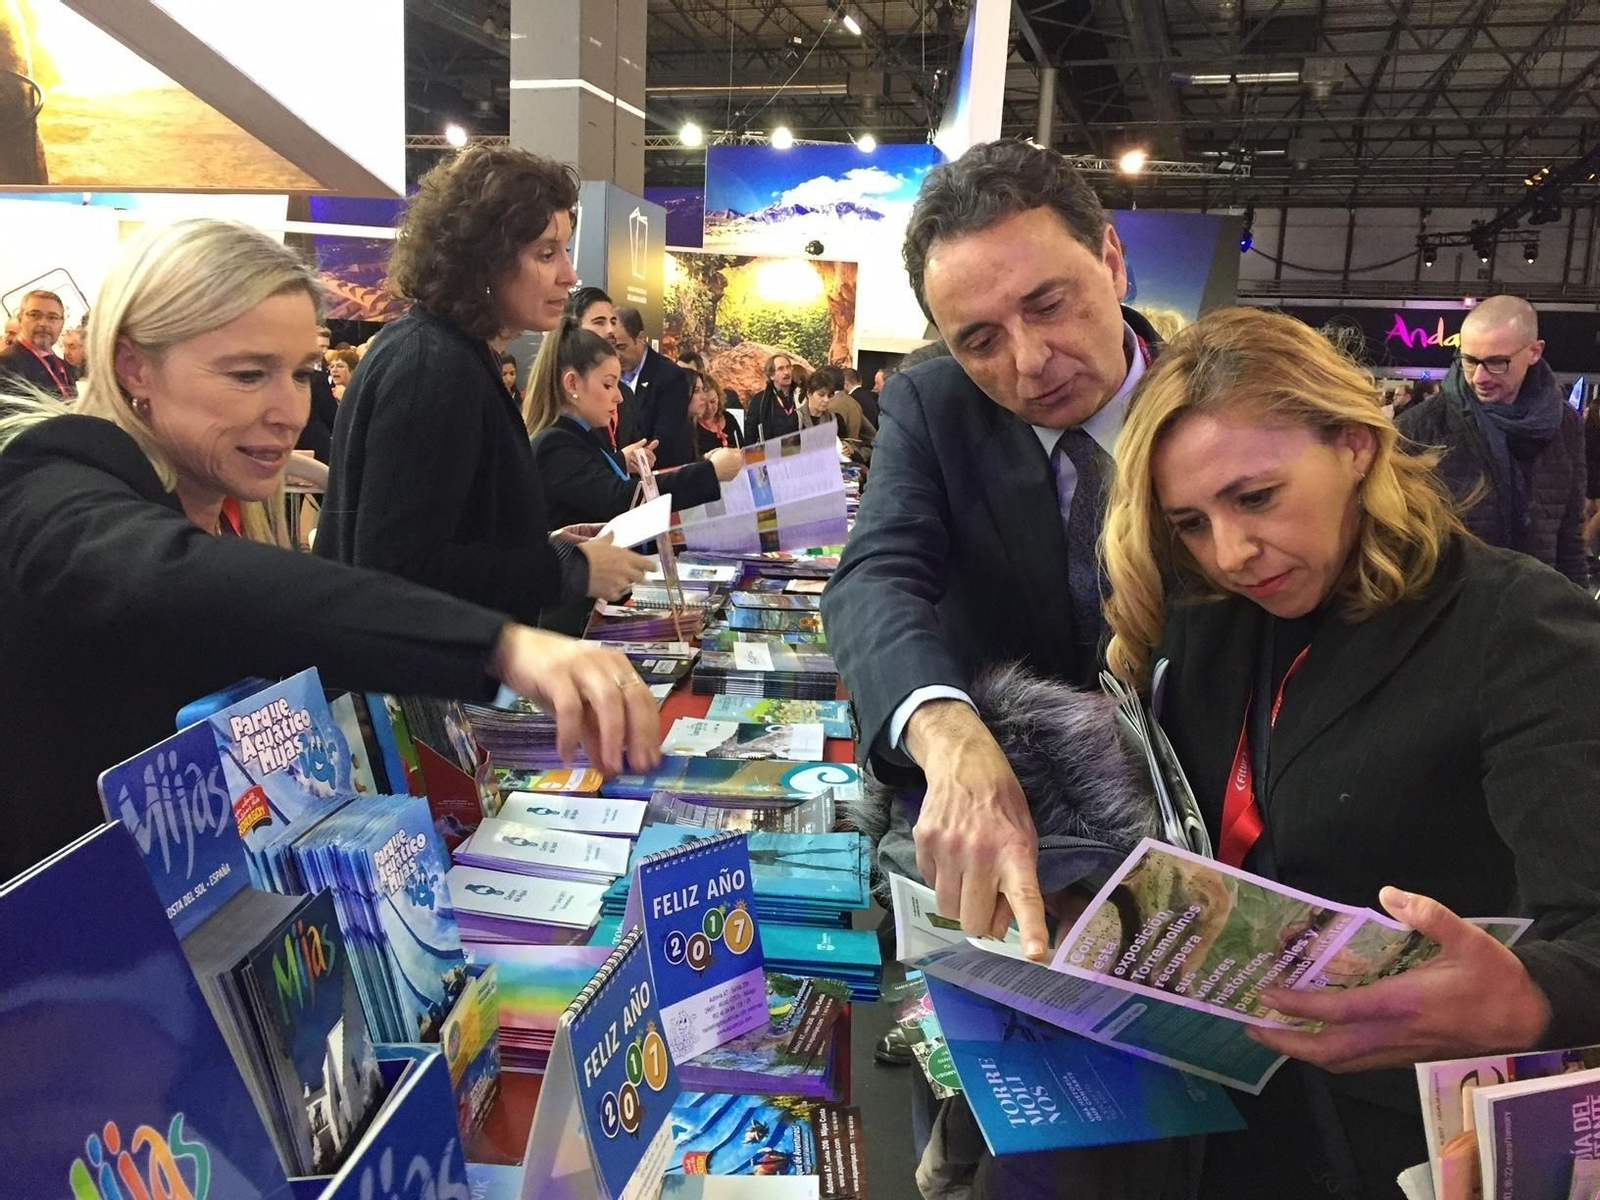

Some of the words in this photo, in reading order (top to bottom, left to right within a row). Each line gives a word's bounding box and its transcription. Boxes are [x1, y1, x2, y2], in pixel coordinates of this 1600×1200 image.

[229, 697, 289, 742] Parque
[1236, 760, 1248, 784] Fitur
[165, 899, 184, 920] OSTA
[182, 890, 195, 908] DEL
[194, 880, 206, 898] SOL
[208, 863, 231, 887] ESPAÑA
[653, 884, 699, 919] FELIZ
[706, 868, 745, 900] AÑO
[1070, 937, 1097, 963] Con
[1094, 941, 1119, 970] esta
[1114, 909, 1175, 976] exposición,
[1130, 904, 1202, 980] Torremolinos
[1155, 934, 1202, 988] recupera
[272, 919, 335, 1026] Mijas
[1175, 972, 1196, 994] sus
[1194, 957, 1236, 998] valores
[1211, 951, 1275, 1005] históricos,
[1234, 938, 1309, 1012] patrimoniales
[583, 1021, 621, 1088] FELIZ
[623, 981, 651, 1035] AÑO
[819, 1108, 827, 1122] Costa
[979, 1058, 1026, 1128] TORRE
[1006, 1076, 1049, 1126] MOLI
[1030, 1086, 1067, 1123] NOS
[1572, 1095, 1594, 1132] DEL
[820, 1123, 829, 1136] Mijas
